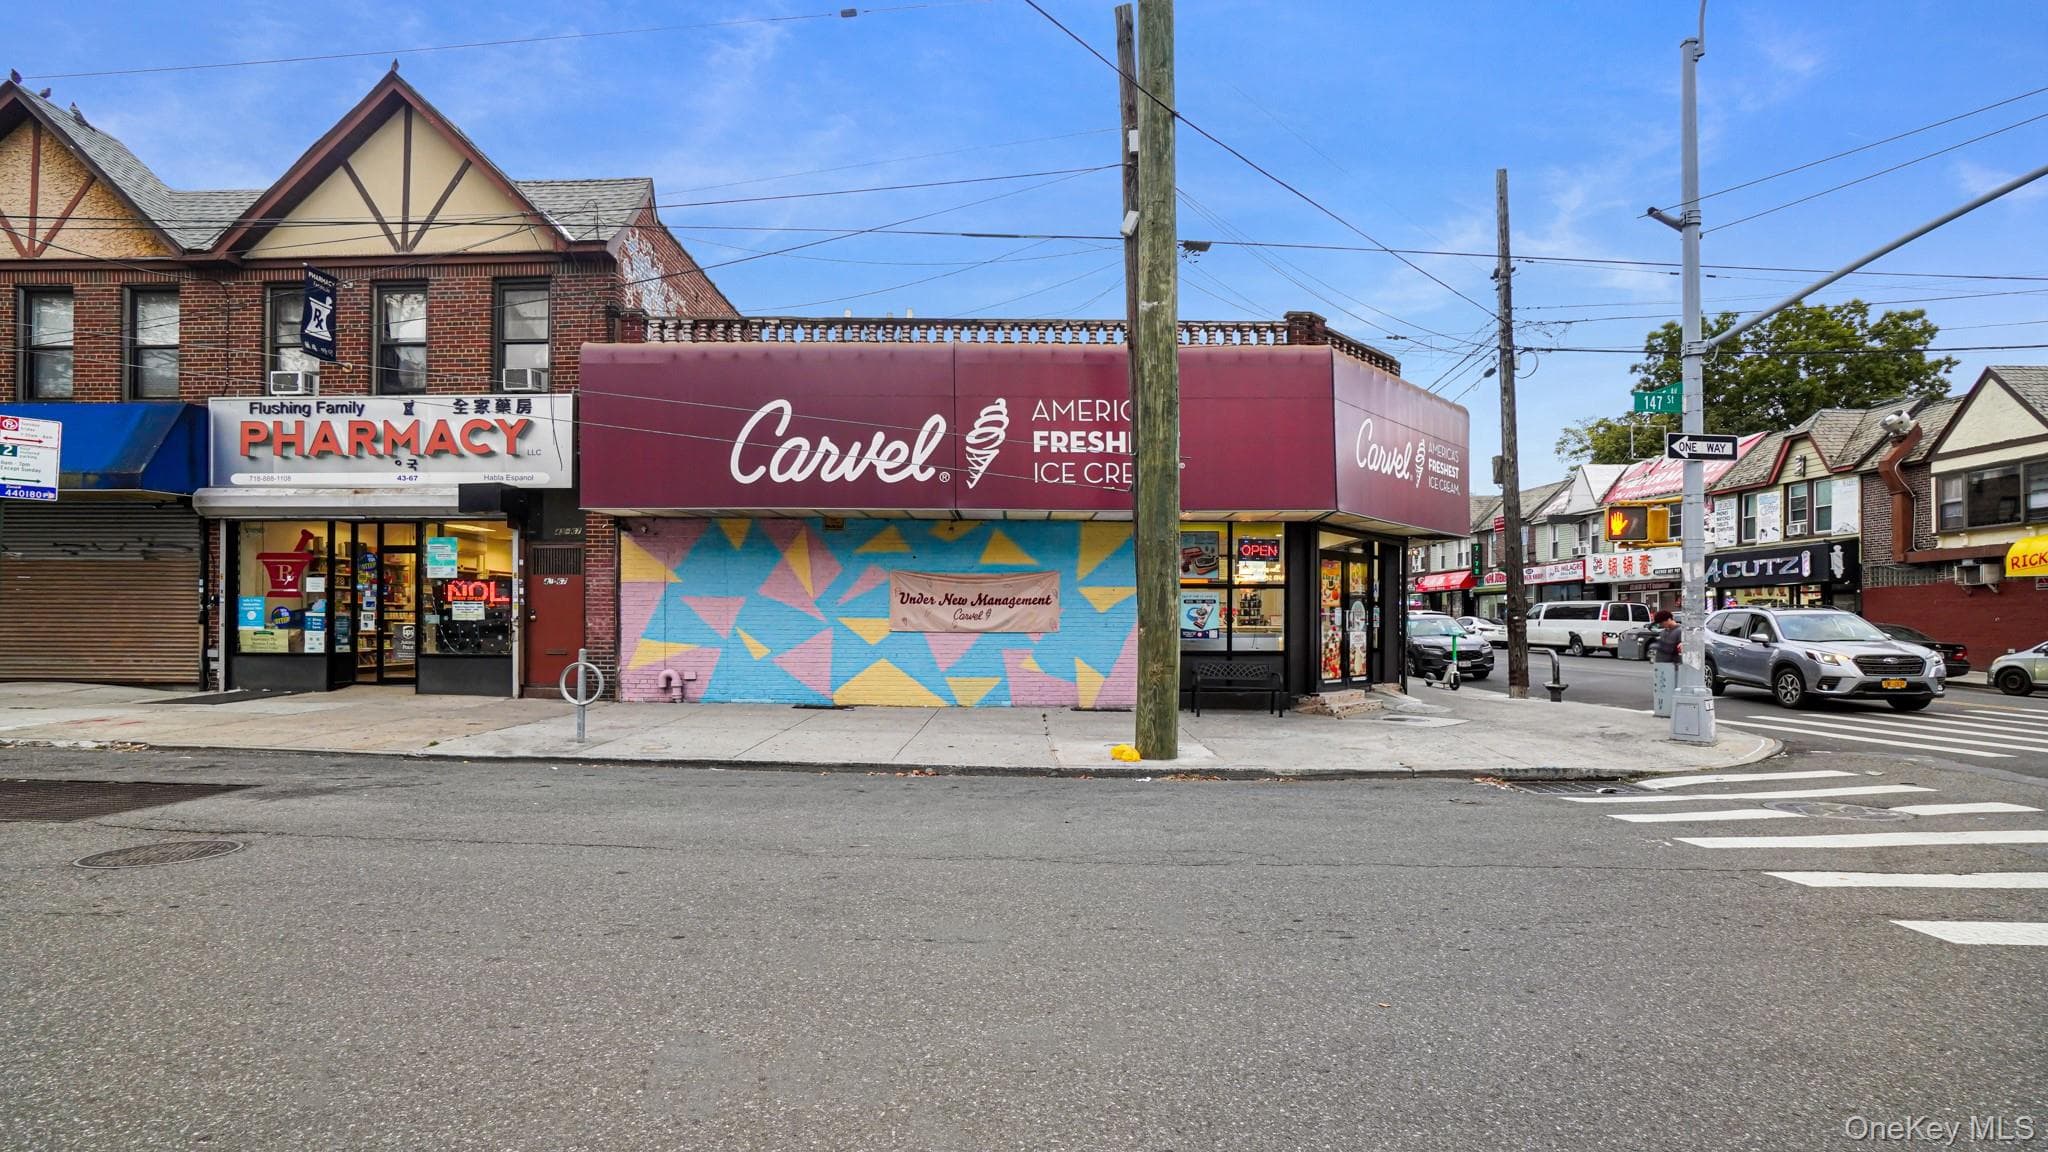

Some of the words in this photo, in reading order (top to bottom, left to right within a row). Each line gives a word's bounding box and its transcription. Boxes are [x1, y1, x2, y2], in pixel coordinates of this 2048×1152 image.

[308, 271, 335, 287] PHARMACY
[249, 402, 311, 417] Flushing
[316, 401, 365, 416] Family
[1644, 395, 1663, 410] 147
[1667, 396, 1674, 404] St
[240, 419, 529, 456] PHARMACY
[730, 399, 947, 484] Carvel
[1033, 431, 1132, 453] FRESH
[3, 445, 13, 456] 2
[1356, 418, 1410, 480] Carvel
[1679, 443, 1697, 453] ONE
[1706, 443, 1726, 453] WAY
[1034, 462, 1076, 483] ICE
[1428, 458, 1460, 479] FRESHEST
[1428, 475, 1439, 490] ICE
[1241, 544, 1278, 557] OPEN
[899, 592, 935, 605] Under
[938, 594, 967, 606] New
[970, 592, 1052, 608] Management
[953, 608, 983, 621] Carvel
